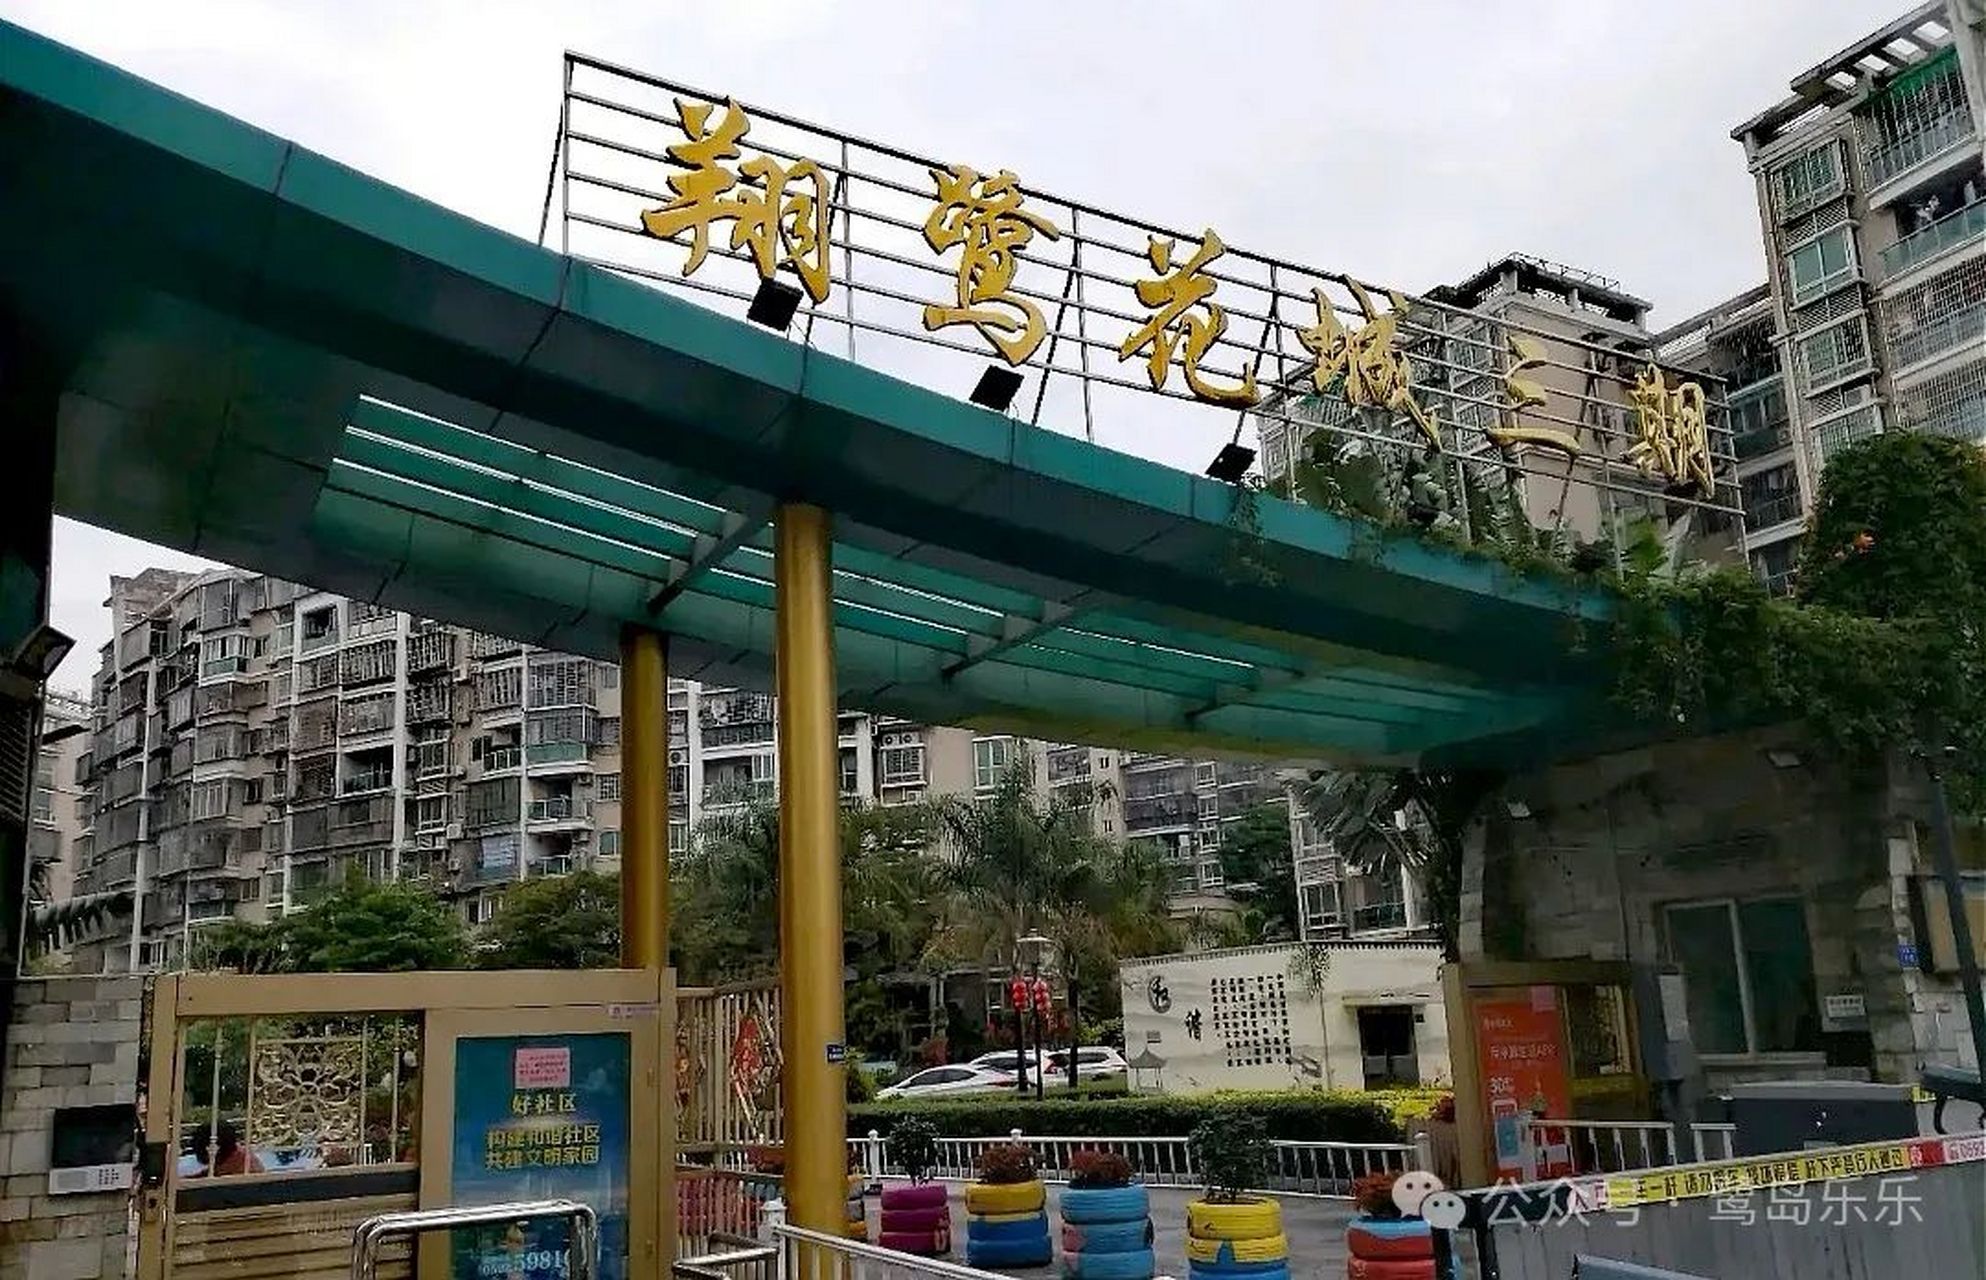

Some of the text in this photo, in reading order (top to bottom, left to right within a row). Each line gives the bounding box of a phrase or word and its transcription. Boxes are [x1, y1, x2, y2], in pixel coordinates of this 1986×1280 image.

[511, 1093, 577, 1116] 好社区
[486, 1124, 601, 1149] 构建和谐社区
[485, 1144, 600, 1170] 共建文明家园
